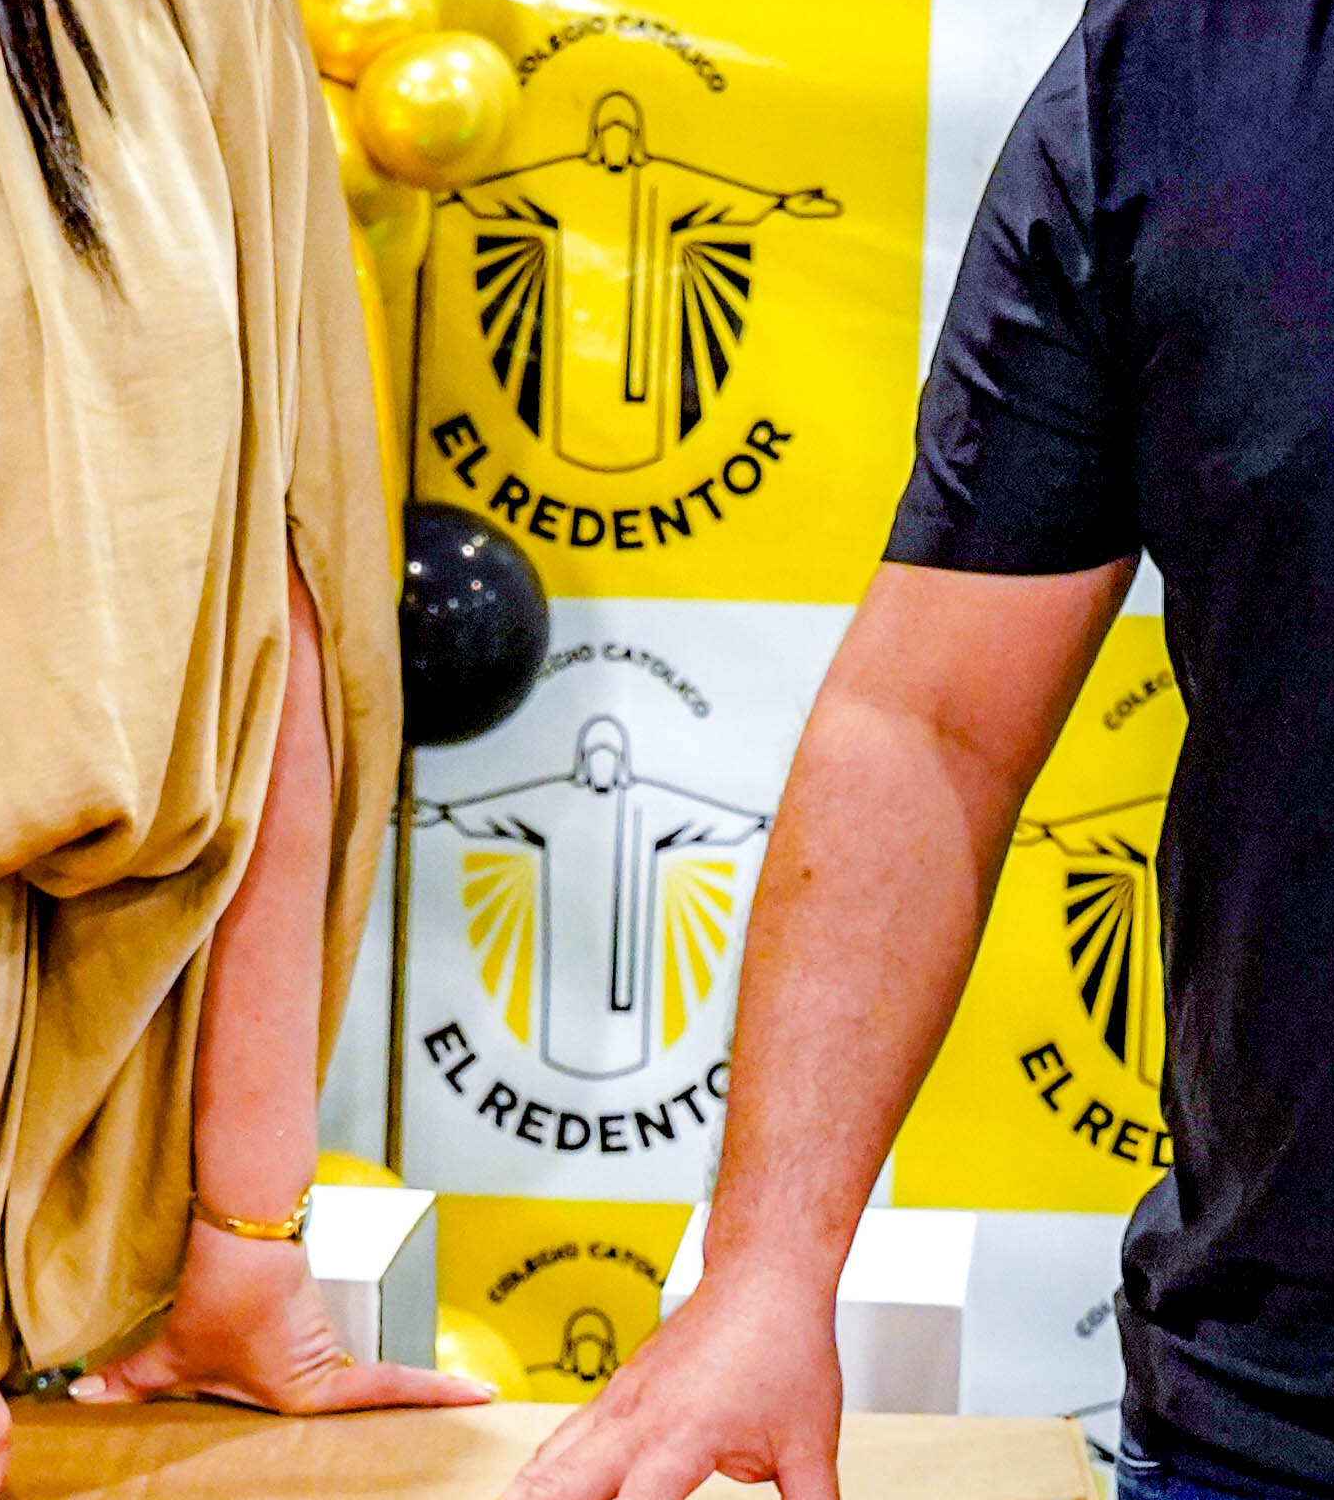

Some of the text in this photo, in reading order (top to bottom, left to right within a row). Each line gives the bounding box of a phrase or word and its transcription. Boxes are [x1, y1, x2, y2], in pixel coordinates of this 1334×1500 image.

[517, 16, 607, 88] OLEGIO
[430, 414, 794, 551] EL REDENTOR
[601, 642, 713, 720] CATOLICO
[1103, 670, 1175, 733] COLEG
[423, 1022, 731, 1154] EL REDENTO
[1019, 1040, 1075, 1113] EL
